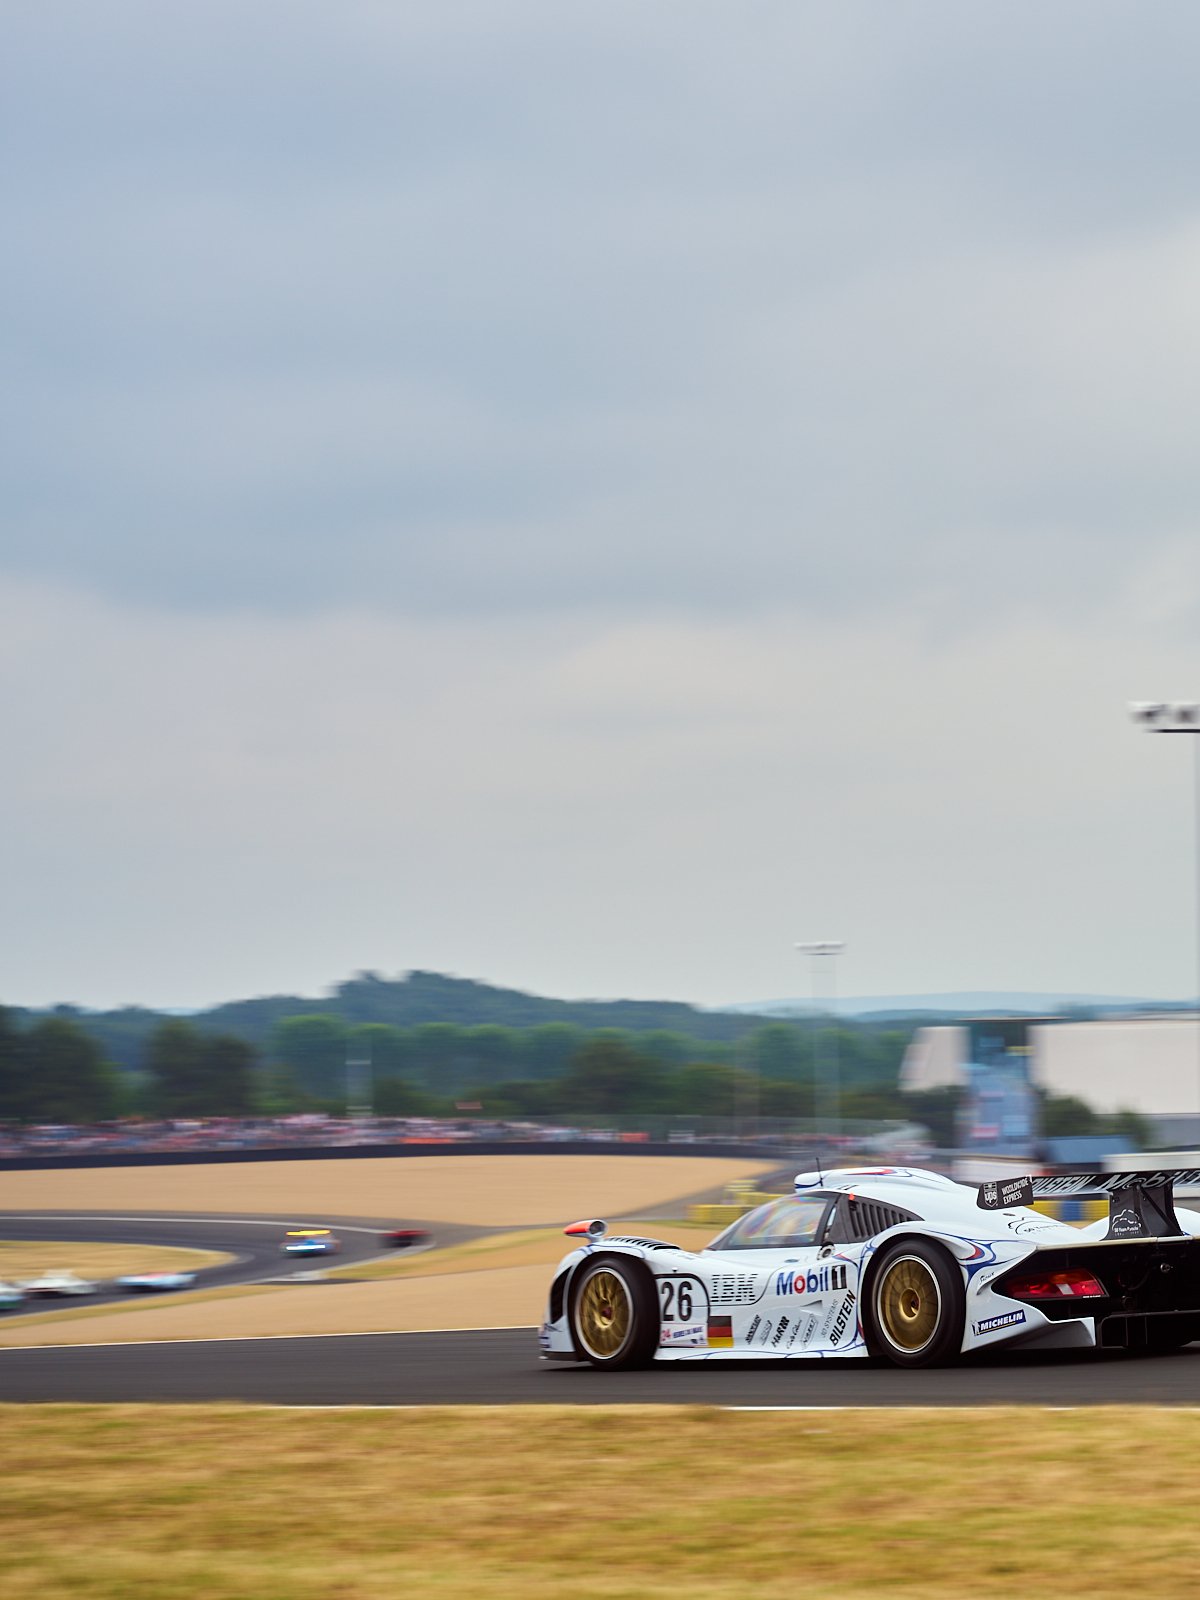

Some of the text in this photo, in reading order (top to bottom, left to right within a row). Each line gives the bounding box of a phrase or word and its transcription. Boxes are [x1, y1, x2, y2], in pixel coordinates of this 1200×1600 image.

[985, 1191, 997, 1204] ups
[1001, 1177, 1029, 1195] WORLDWIDE
[1003, 1190, 1023, 1205] EXPRESS
[710, 1273, 759, 1302] IBM
[776, 1265, 844, 1295] Mobil 1
[661, 1281, 693, 1321] 26
[829, 1289, 857, 1347] BILSTEIN
[980, 1312, 1024, 1331] MICHELIN
